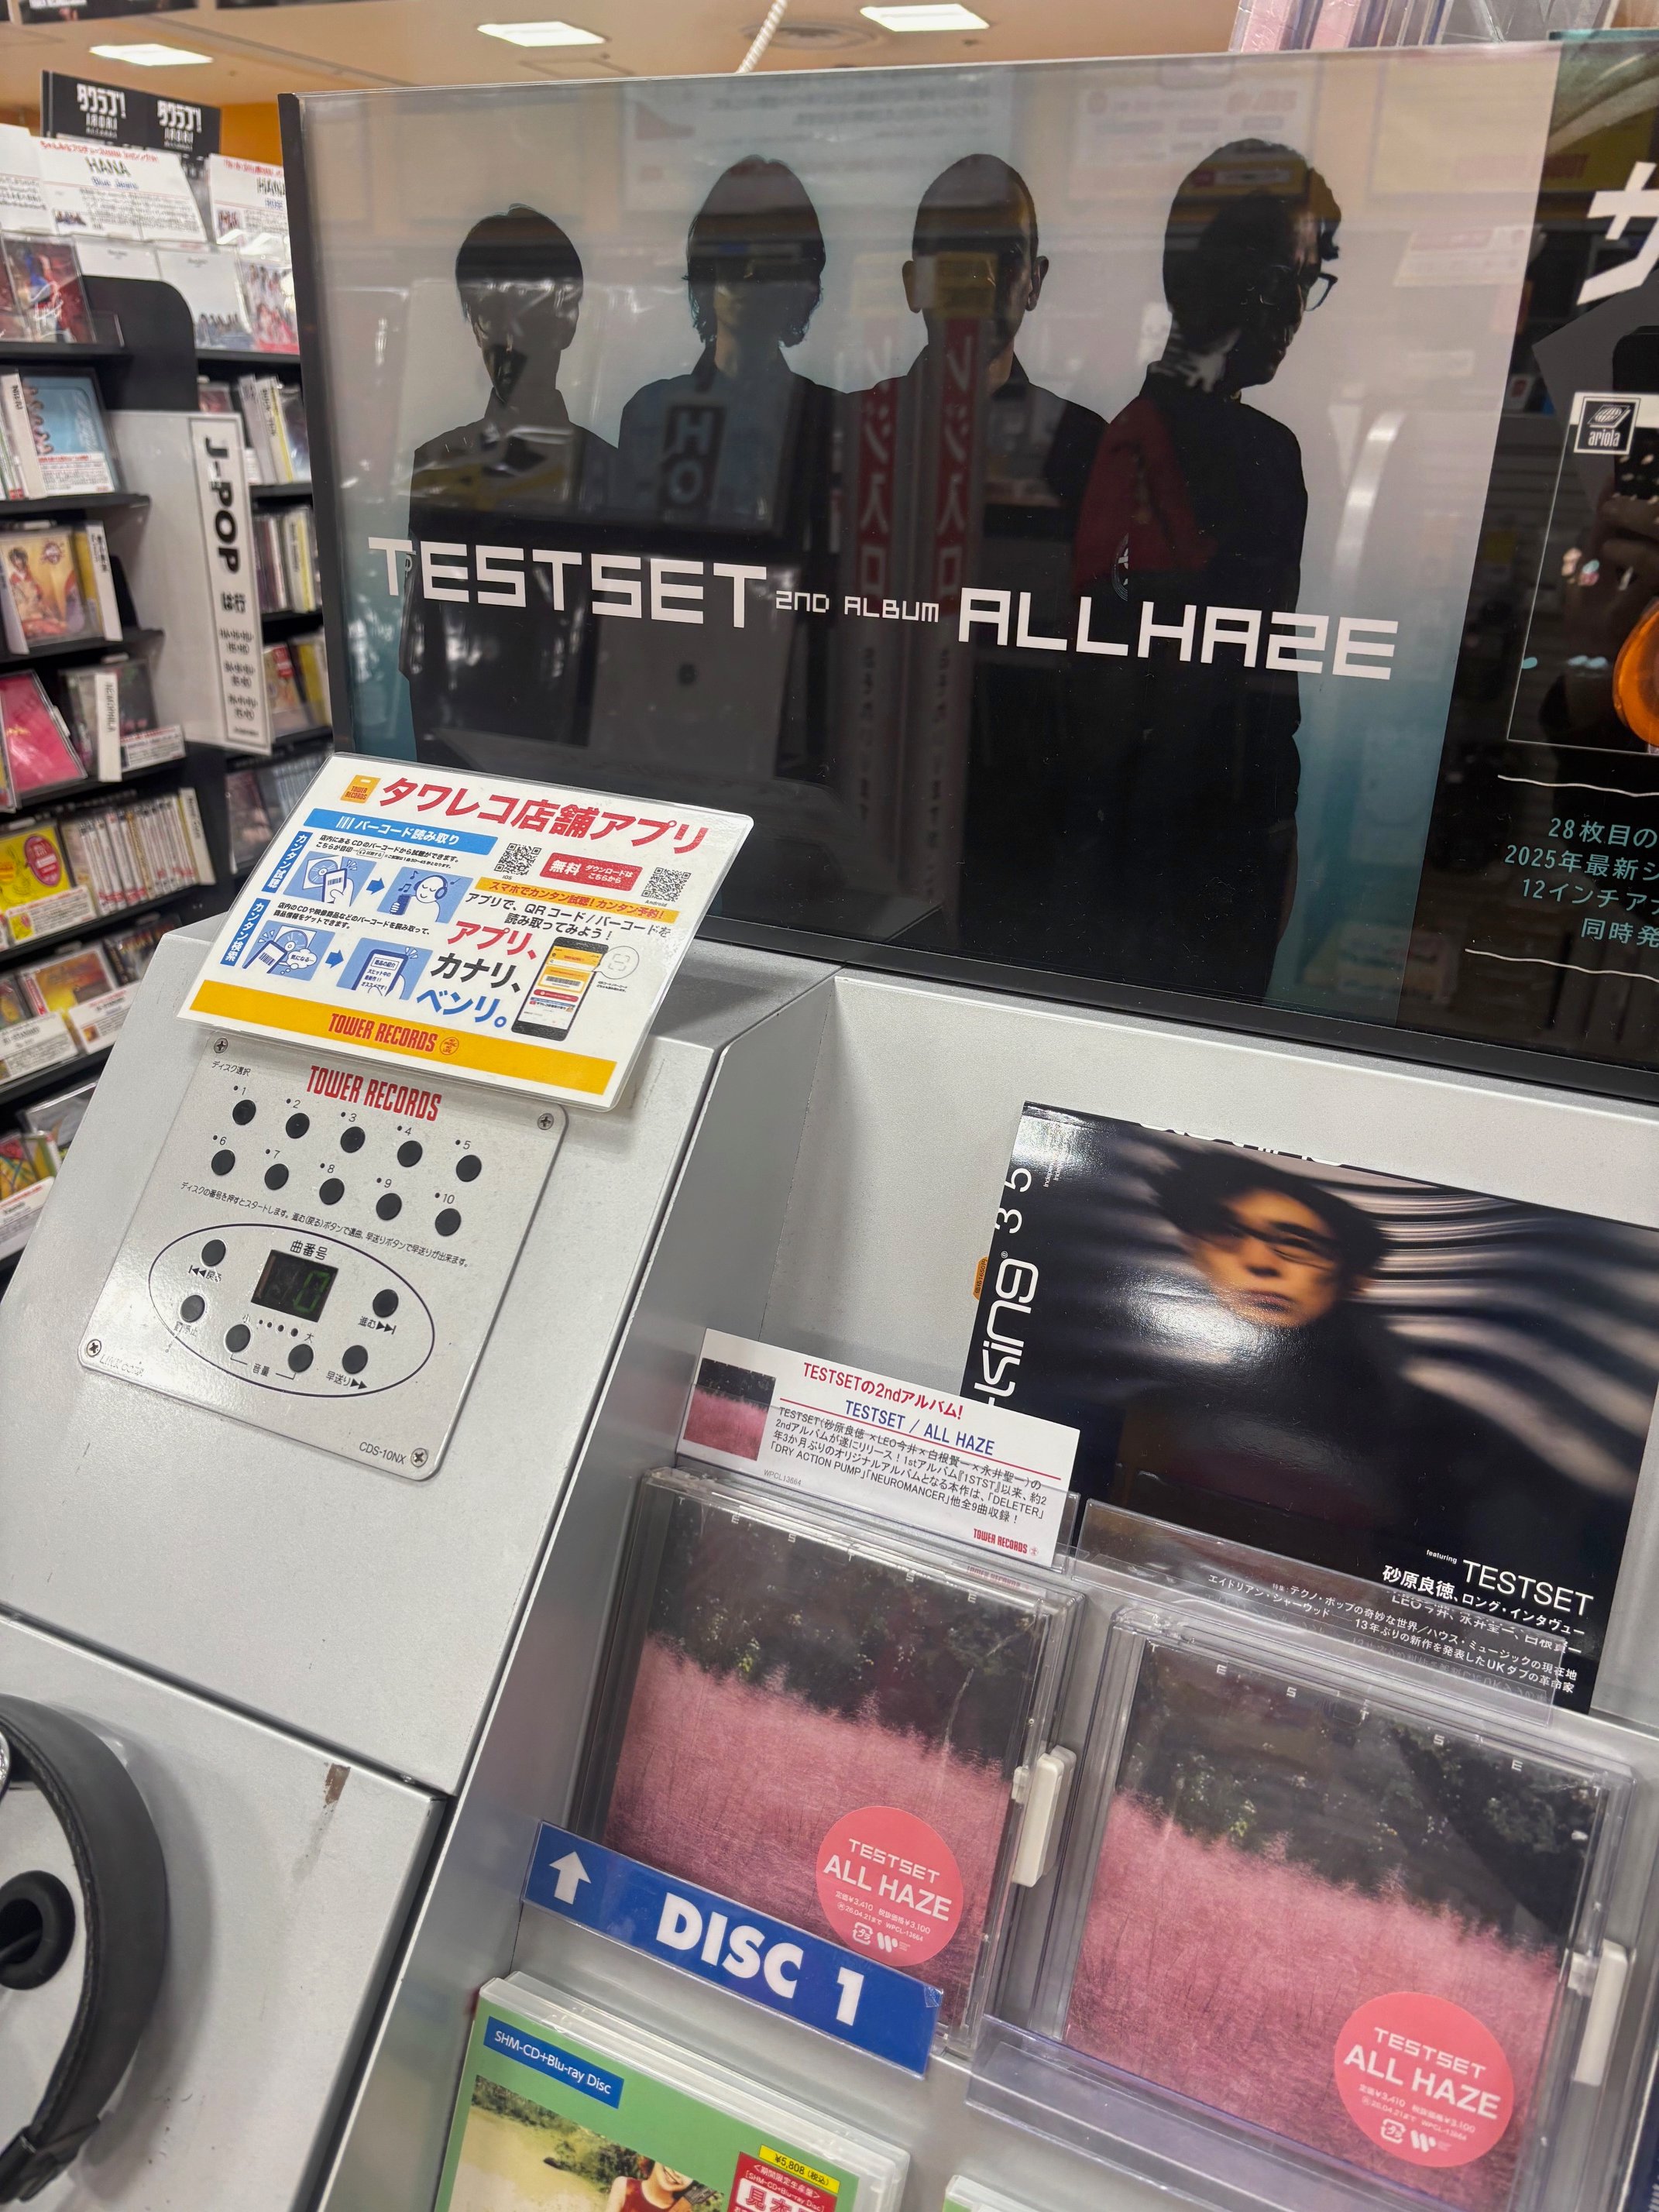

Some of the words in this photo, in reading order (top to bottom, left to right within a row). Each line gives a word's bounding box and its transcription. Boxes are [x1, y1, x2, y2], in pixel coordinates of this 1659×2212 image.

[85, 157, 132, 177] HANA
[1588, 428, 1620, 448] ariola
[204, 434, 241, 575] J-POP
[368, 537, 768, 628] TESTSET
[844, 590, 939, 623] ALBUM
[380, 778, 709, 854] タワレコ店舗アプリ
[355, 820, 460, 845] バーコード読み取り
[1548, 817, 1657, 849] 28枚目の
[549, 860, 582, 876] 無料
[585, 864, 634, 878] ダウンロードは
[588, 873, 622, 884] こちらから
[225, 902, 266, 962] カンタン検索
[448, 921, 538, 960] アプリ、
[431, 952, 521, 993] カナリ、
[417, 989, 507, 1029] ベンリ。
[328, 1013, 376, 1039] TOWER
[374, 1022, 438, 1053] RECORDS
[211, 1060, 252, 1076] ディスク選択
[241, 1087, 246, 1095] 1
[306, 1065, 364, 1104] TOWER
[363, 1079, 441, 1121] RECORDS
[294, 1099, 301, 1108] 2
[349, 1113, 357, 1122] 3
[219, 1136, 227, 1145] 6
[404, 1126, 412, 1135] 4
[273, 1149, 280, 1159] 7
[462, 1140, 472, 1150] 5
[327, 1164, 335, 1173] 8
[384, 1178, 393, 1188] 9
[442, 1194, 455, 1204] 10
[290, 1241, 328, 1261] 曲番号
[358, 1316, 376, 1328] 進む
[304, 1332, 314, 1341] 大
[326, 1371, 351, 1386] 早送り
[803, 1362, 963, 1420] TESTSETの2ndアルバム!
[846, 1400, 905, 1430] TESTSET
[923, 1424, 950, 1443] ALL
[956, 1431, 994, 1455] HAZE
[359, 1441, 407, 1464] CDS-10NX
[796, 1451, 832, 1468] ACTION
[973, 1528, 995, 1543] TOWER
[997, 1536, 1028, 1554] RECORDS
[1426, 1549, 1457, 1564] featuring
[1462, 1559, 1594, 1616] TESTSET
[849, 1838, 940, 1884] TESTSET
[823, 1854, 871, 1891] ALL
[878, 1874, 952, 1922] HAZE
[655, 1892, 804, 1999] DISC
[836, 1966, 864, 2027] 1
[494, 2030, 585, 2083] SHM-CD+Blu-ray
[587, 2073, 611, 2095] Disc
[1374, 2027, 1486, 2079] TESTSET
[1343, 2043, 1403, 2087] ALL
[1411, 2067, 1501, 2120] HAZE
